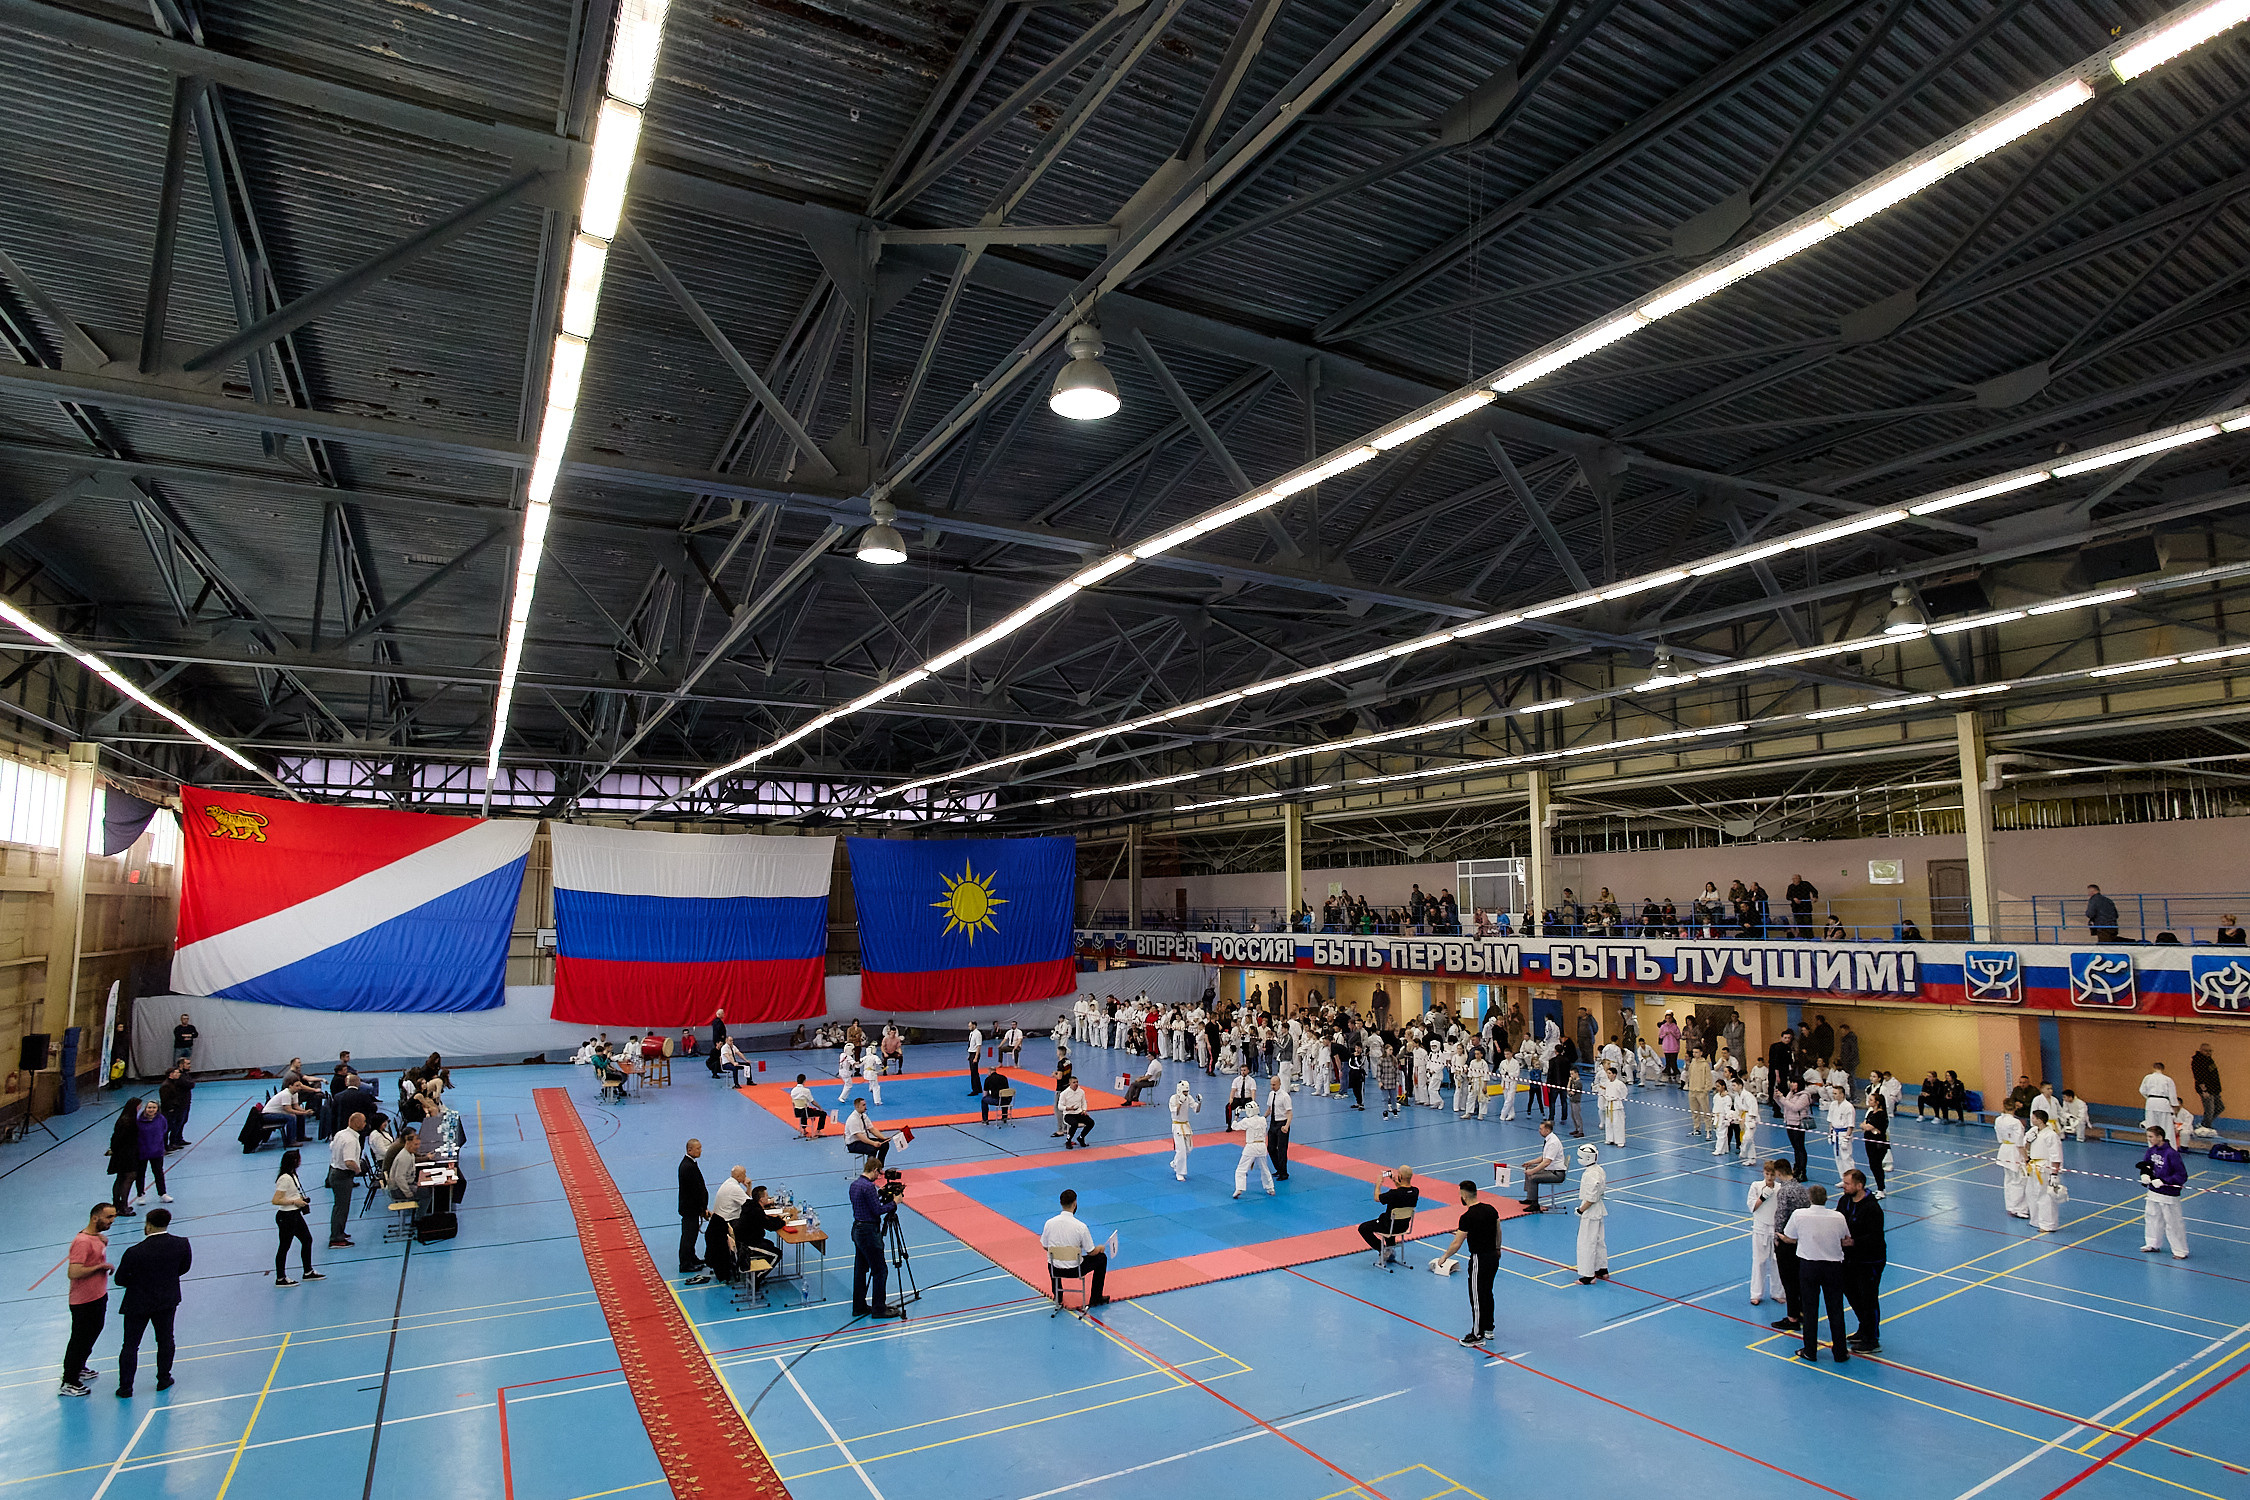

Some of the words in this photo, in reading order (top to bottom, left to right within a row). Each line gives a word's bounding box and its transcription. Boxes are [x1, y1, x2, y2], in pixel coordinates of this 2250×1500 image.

[1136, 932, 1201, 962] ВПЕРЁД,
[1211, 938, 1294, 963] РОССИЯ!
[1313, 940, 1383, 967] БЫТЬ
[1390, 943, 1519, 974] ПЕРВЫМ
[1550, 946, 1661, 980] БЫТЬ
[1673, 948, 1917, 992] ЛУЧШИМ!
